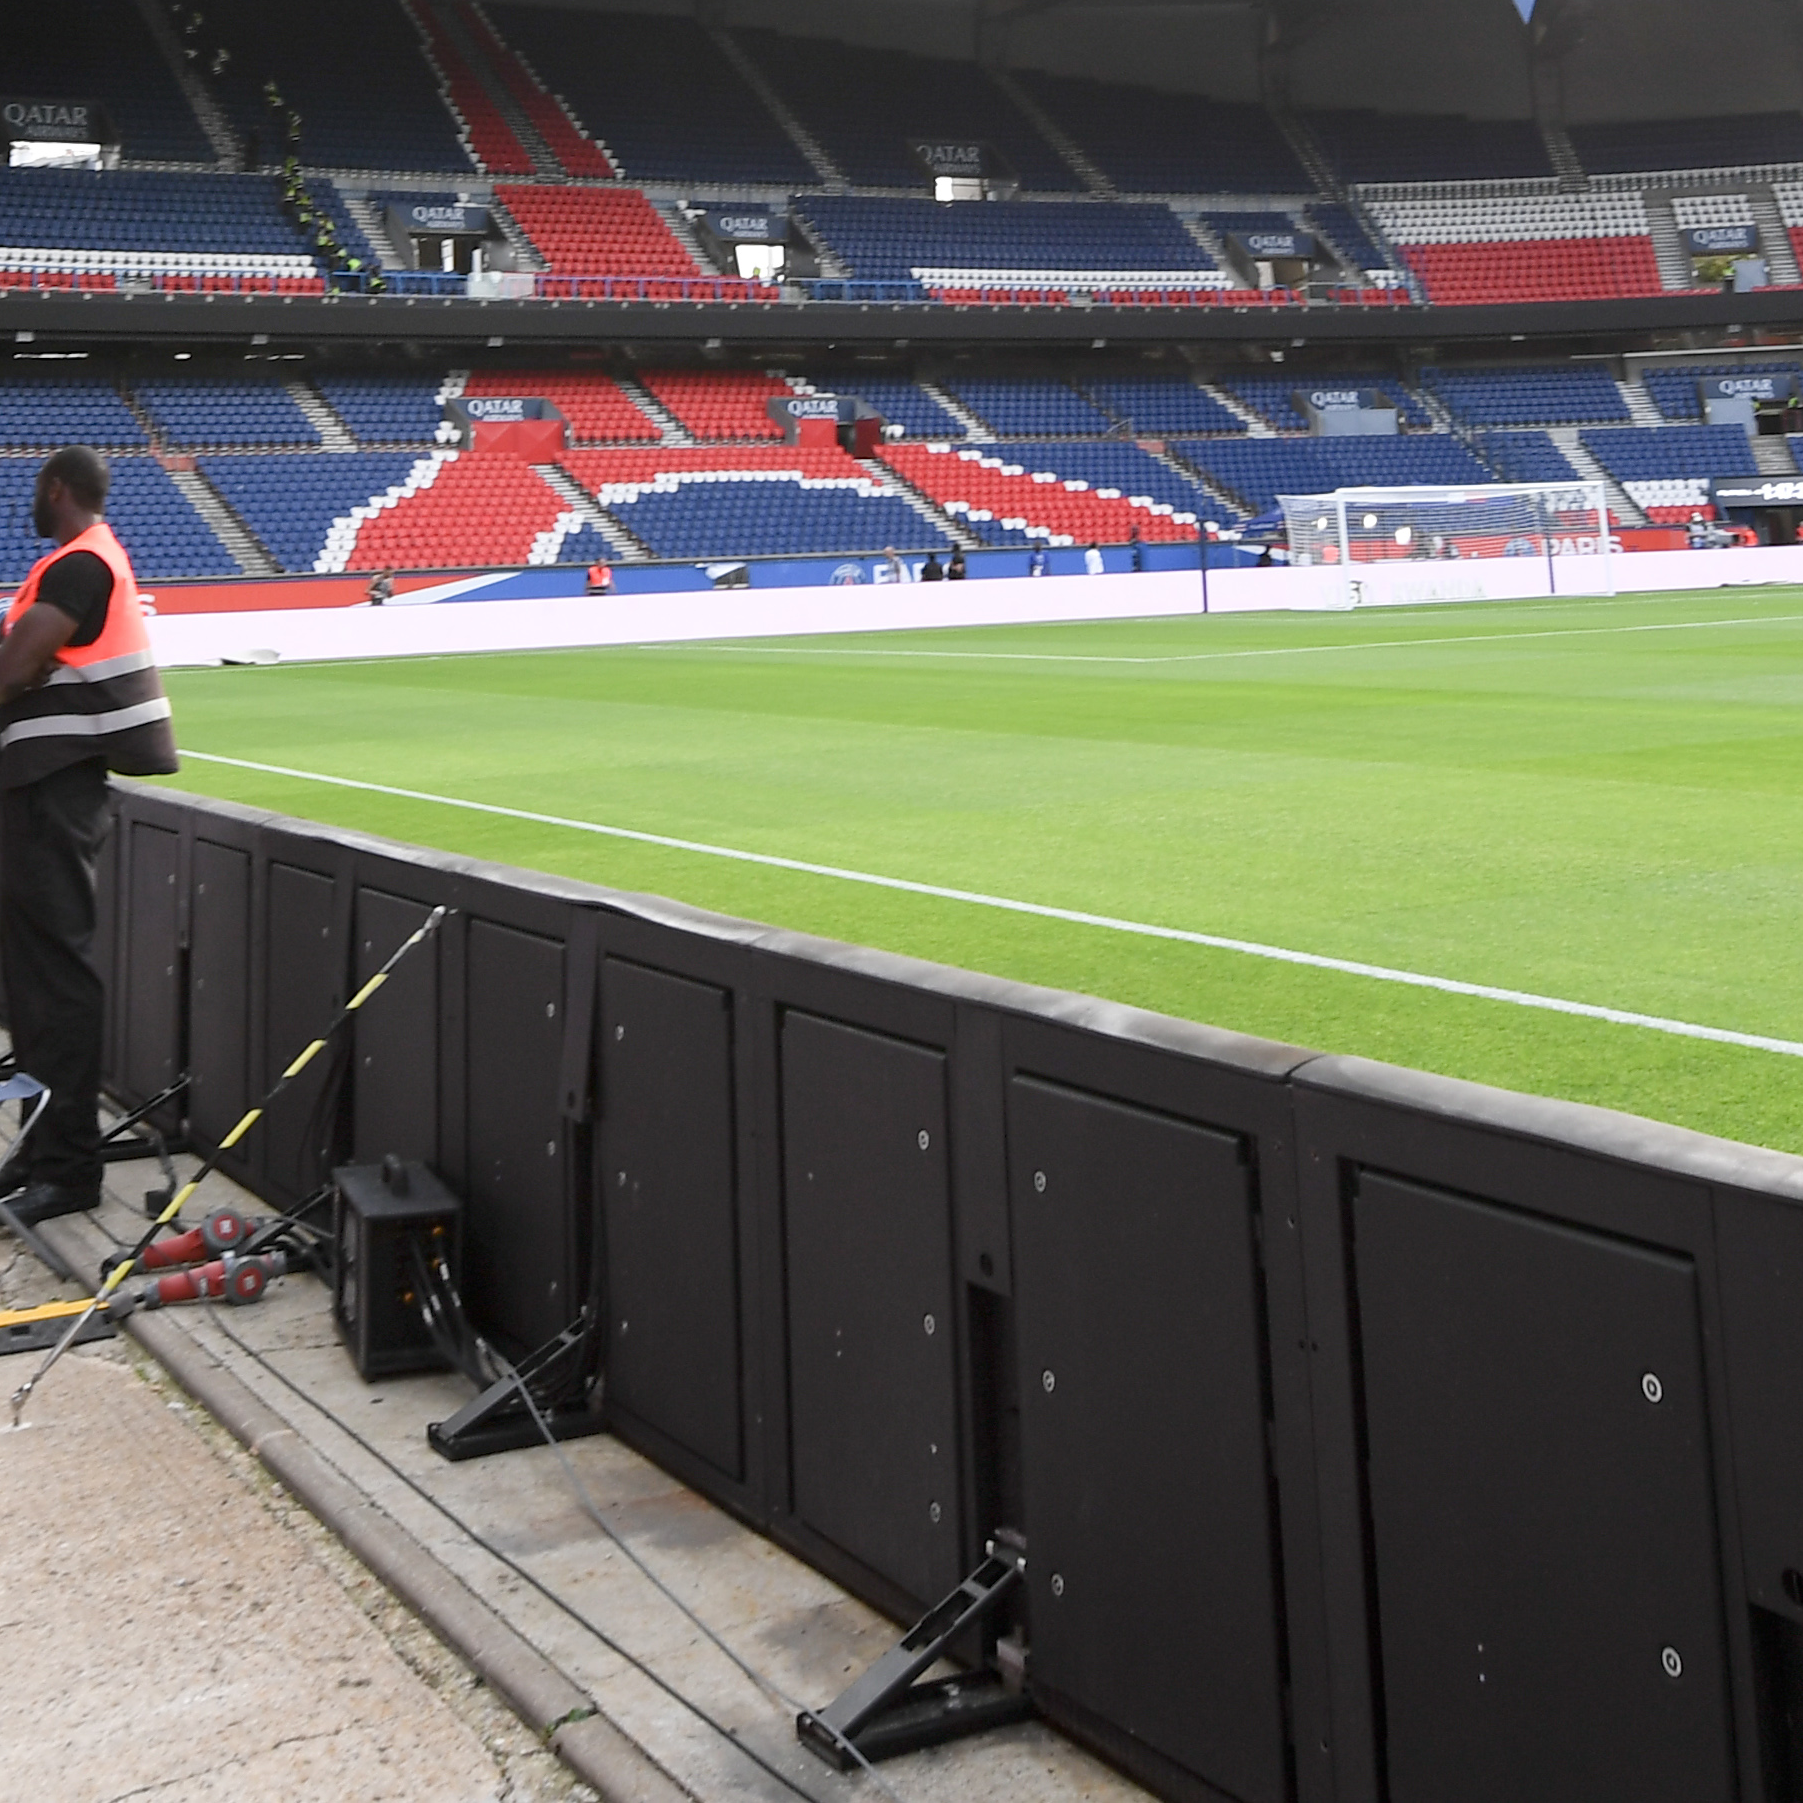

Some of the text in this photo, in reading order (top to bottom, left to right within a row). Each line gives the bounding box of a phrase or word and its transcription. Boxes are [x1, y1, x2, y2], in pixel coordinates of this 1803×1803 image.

[4, 103, 88, 126] QATAR
[412, 207, 465, 222] QATAR
[720, 217, 768, 232] QATAR
[1249, 236, 1295, 249] QATAR
[1692, 228, 1748, 245] QATAR
[1718, 378, 1773, 395] QATAR
[467, 399, 523, 417] QATAR
[787, 399, 838, 417] QATAR
[1310, 391, 1359, 408] QATAR
